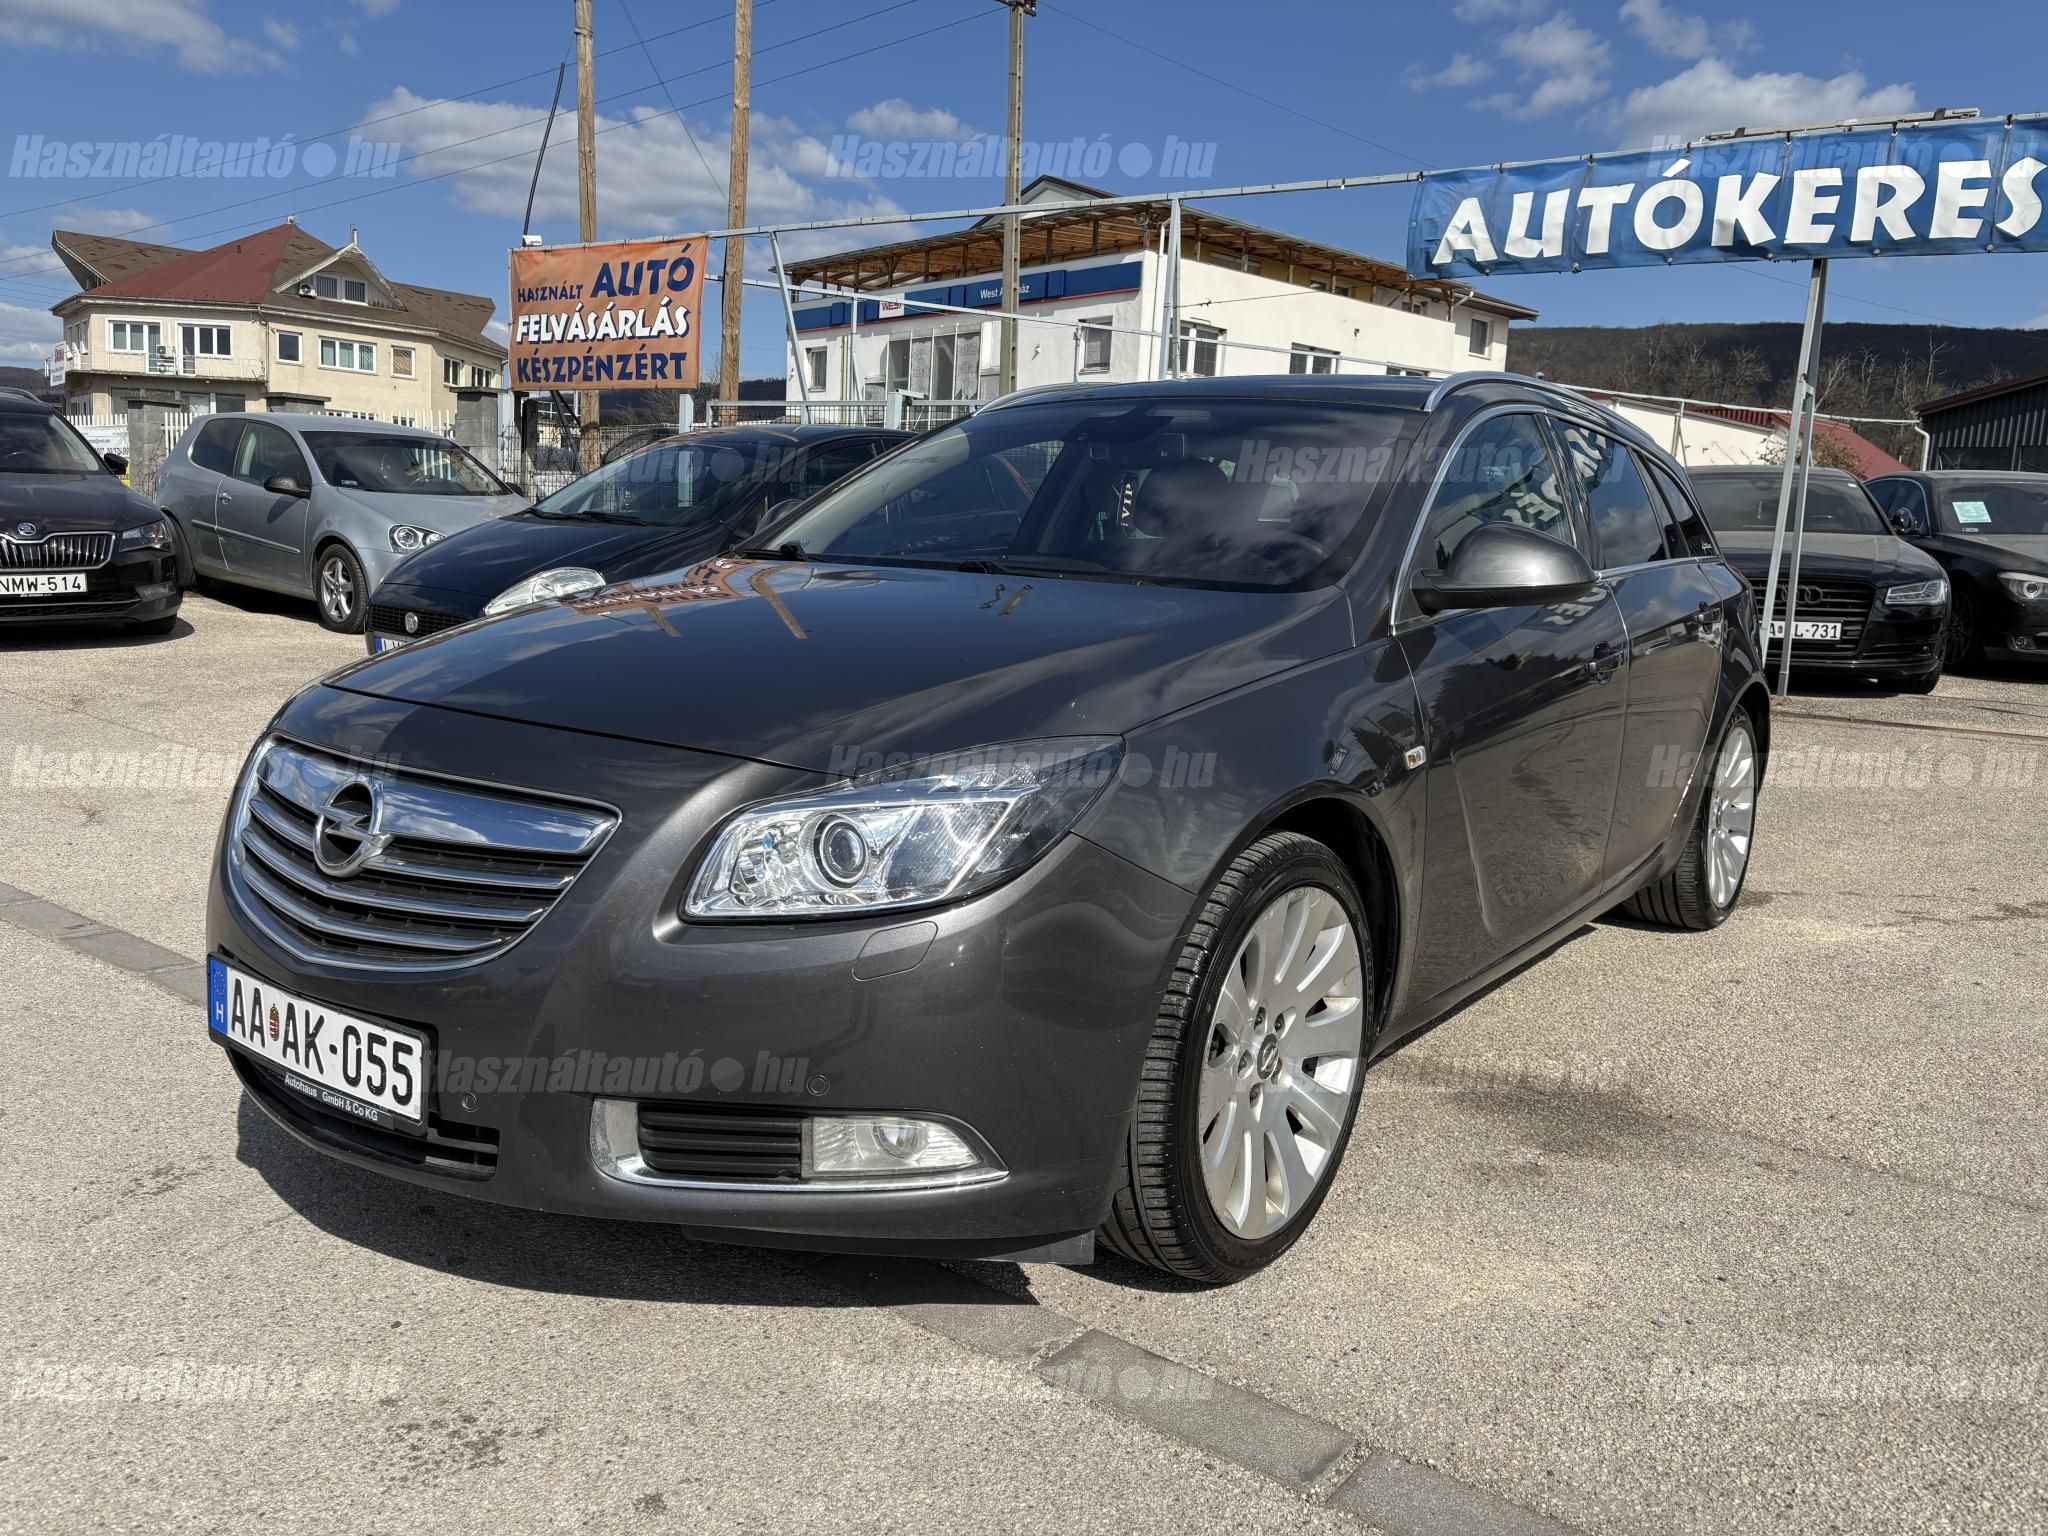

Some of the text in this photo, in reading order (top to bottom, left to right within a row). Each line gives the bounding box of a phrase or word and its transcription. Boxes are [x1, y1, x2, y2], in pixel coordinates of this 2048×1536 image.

[1432, 156, 2048, 265] AUTÓKERES
[518, 243, 695, 302] HASZNÁLT AUTÓ
[516, 296, 691, 344] FELVÁSÁRLÁS
[517, 343, 687, 384] KÉSZPÉNZÉRT
[1792, 623, 1838, 639] L-731
[285, 1075, 378, 1121] Autohaus GmbH & Co KG
